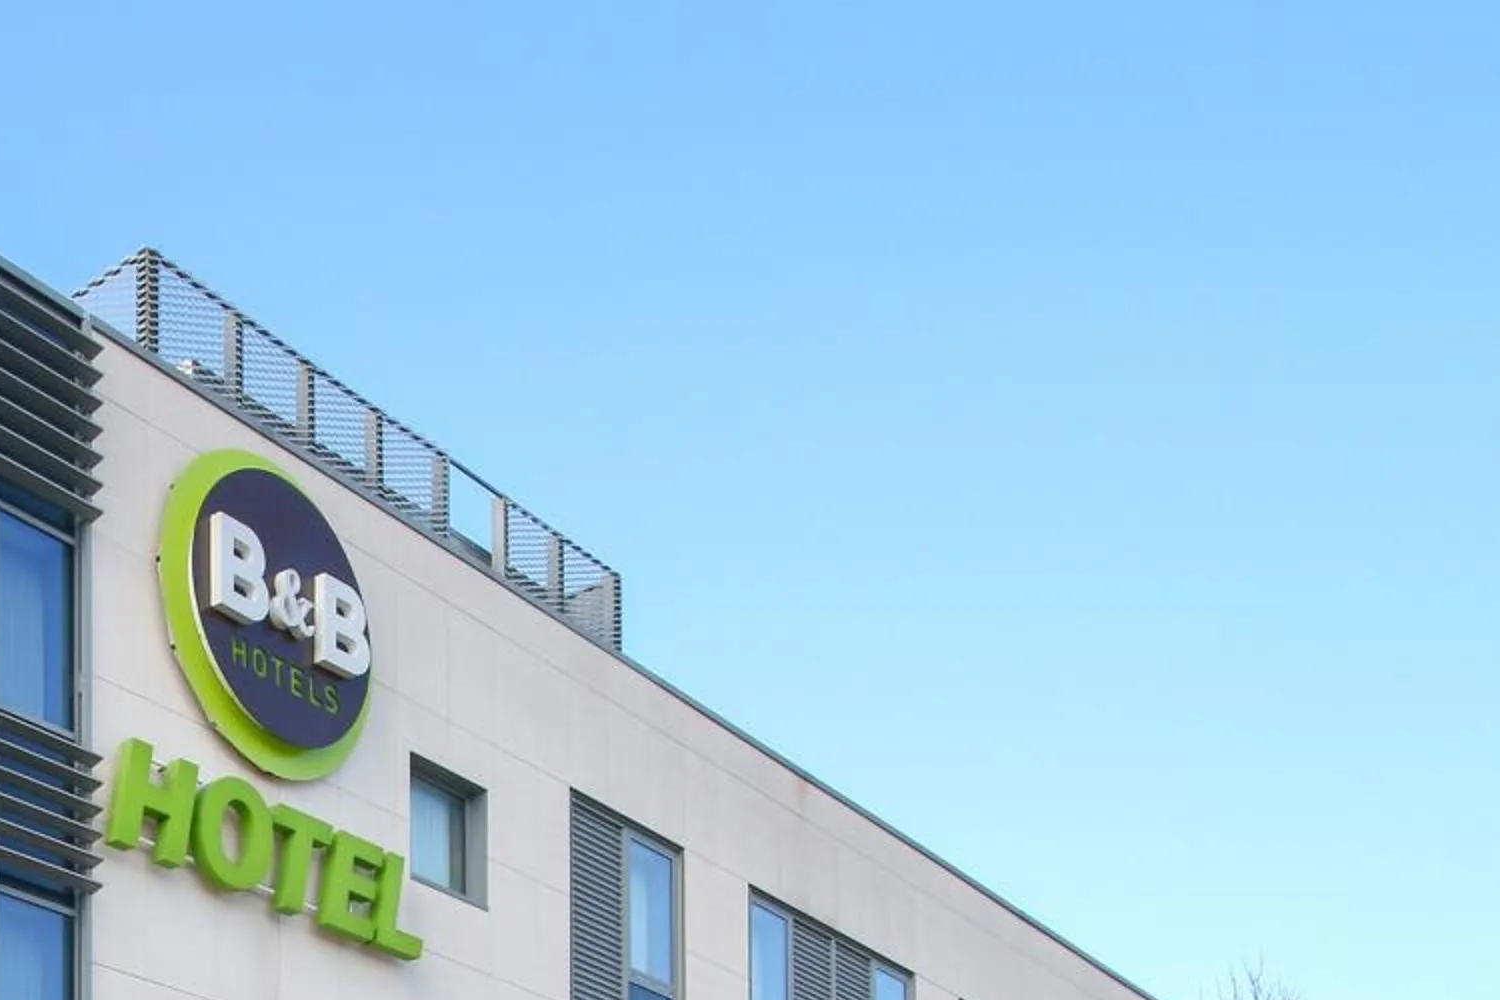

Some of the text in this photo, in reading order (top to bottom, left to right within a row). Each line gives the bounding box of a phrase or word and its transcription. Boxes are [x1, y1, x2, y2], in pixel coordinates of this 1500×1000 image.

[209, 511, 371, 679] B&B
[231, 639, 341, 716] HOTELS
[105, 737, 423, 961] HOTEL
